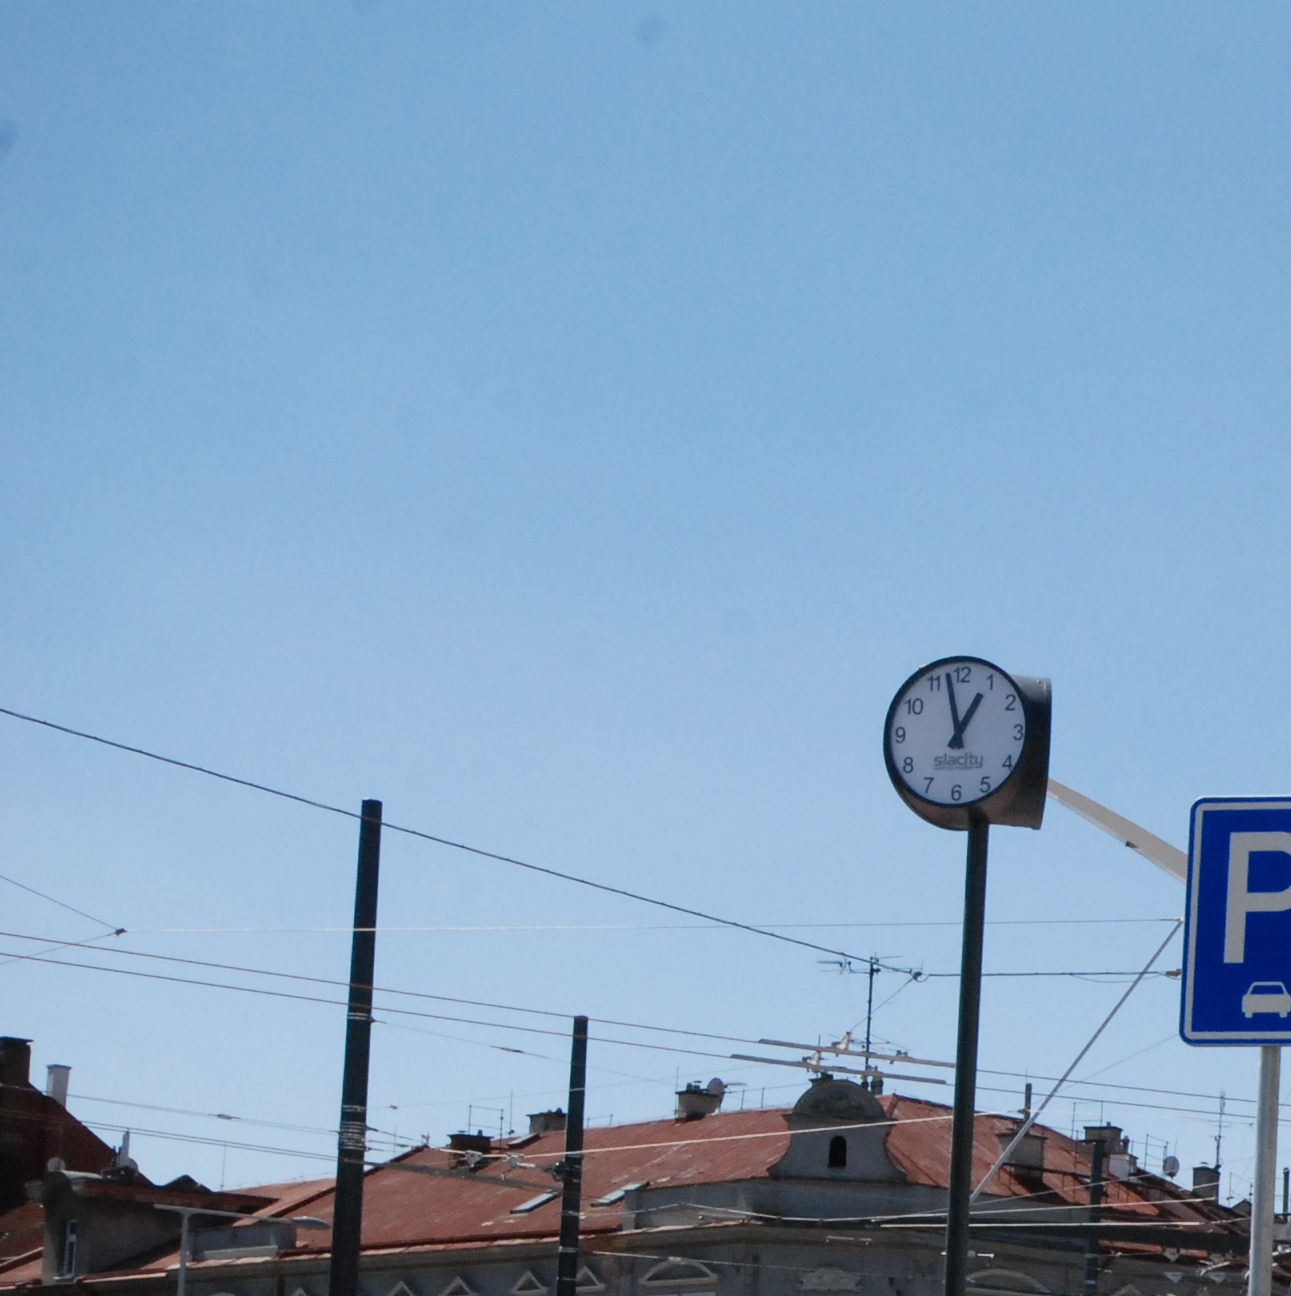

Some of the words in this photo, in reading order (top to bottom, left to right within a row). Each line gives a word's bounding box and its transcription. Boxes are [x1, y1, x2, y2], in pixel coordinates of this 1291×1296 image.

[954, 666, 972, 683] 12
[986, 674, 994, 691] 1
[927, 675, 941, 692] 11
[905, 698, 924, 715] 10
[1005, 694, 1016, 711] 2
[895, 727, 906, 744] 9
[1013, 724, 1024, 741] 3
[903, 757, 914, 773] 8
[1002, 755, 1013, 772] 4
[924, 777, 935, 794] 7
[951, 784, 962, 801] 6
[980, 776, 991, 793] 5
